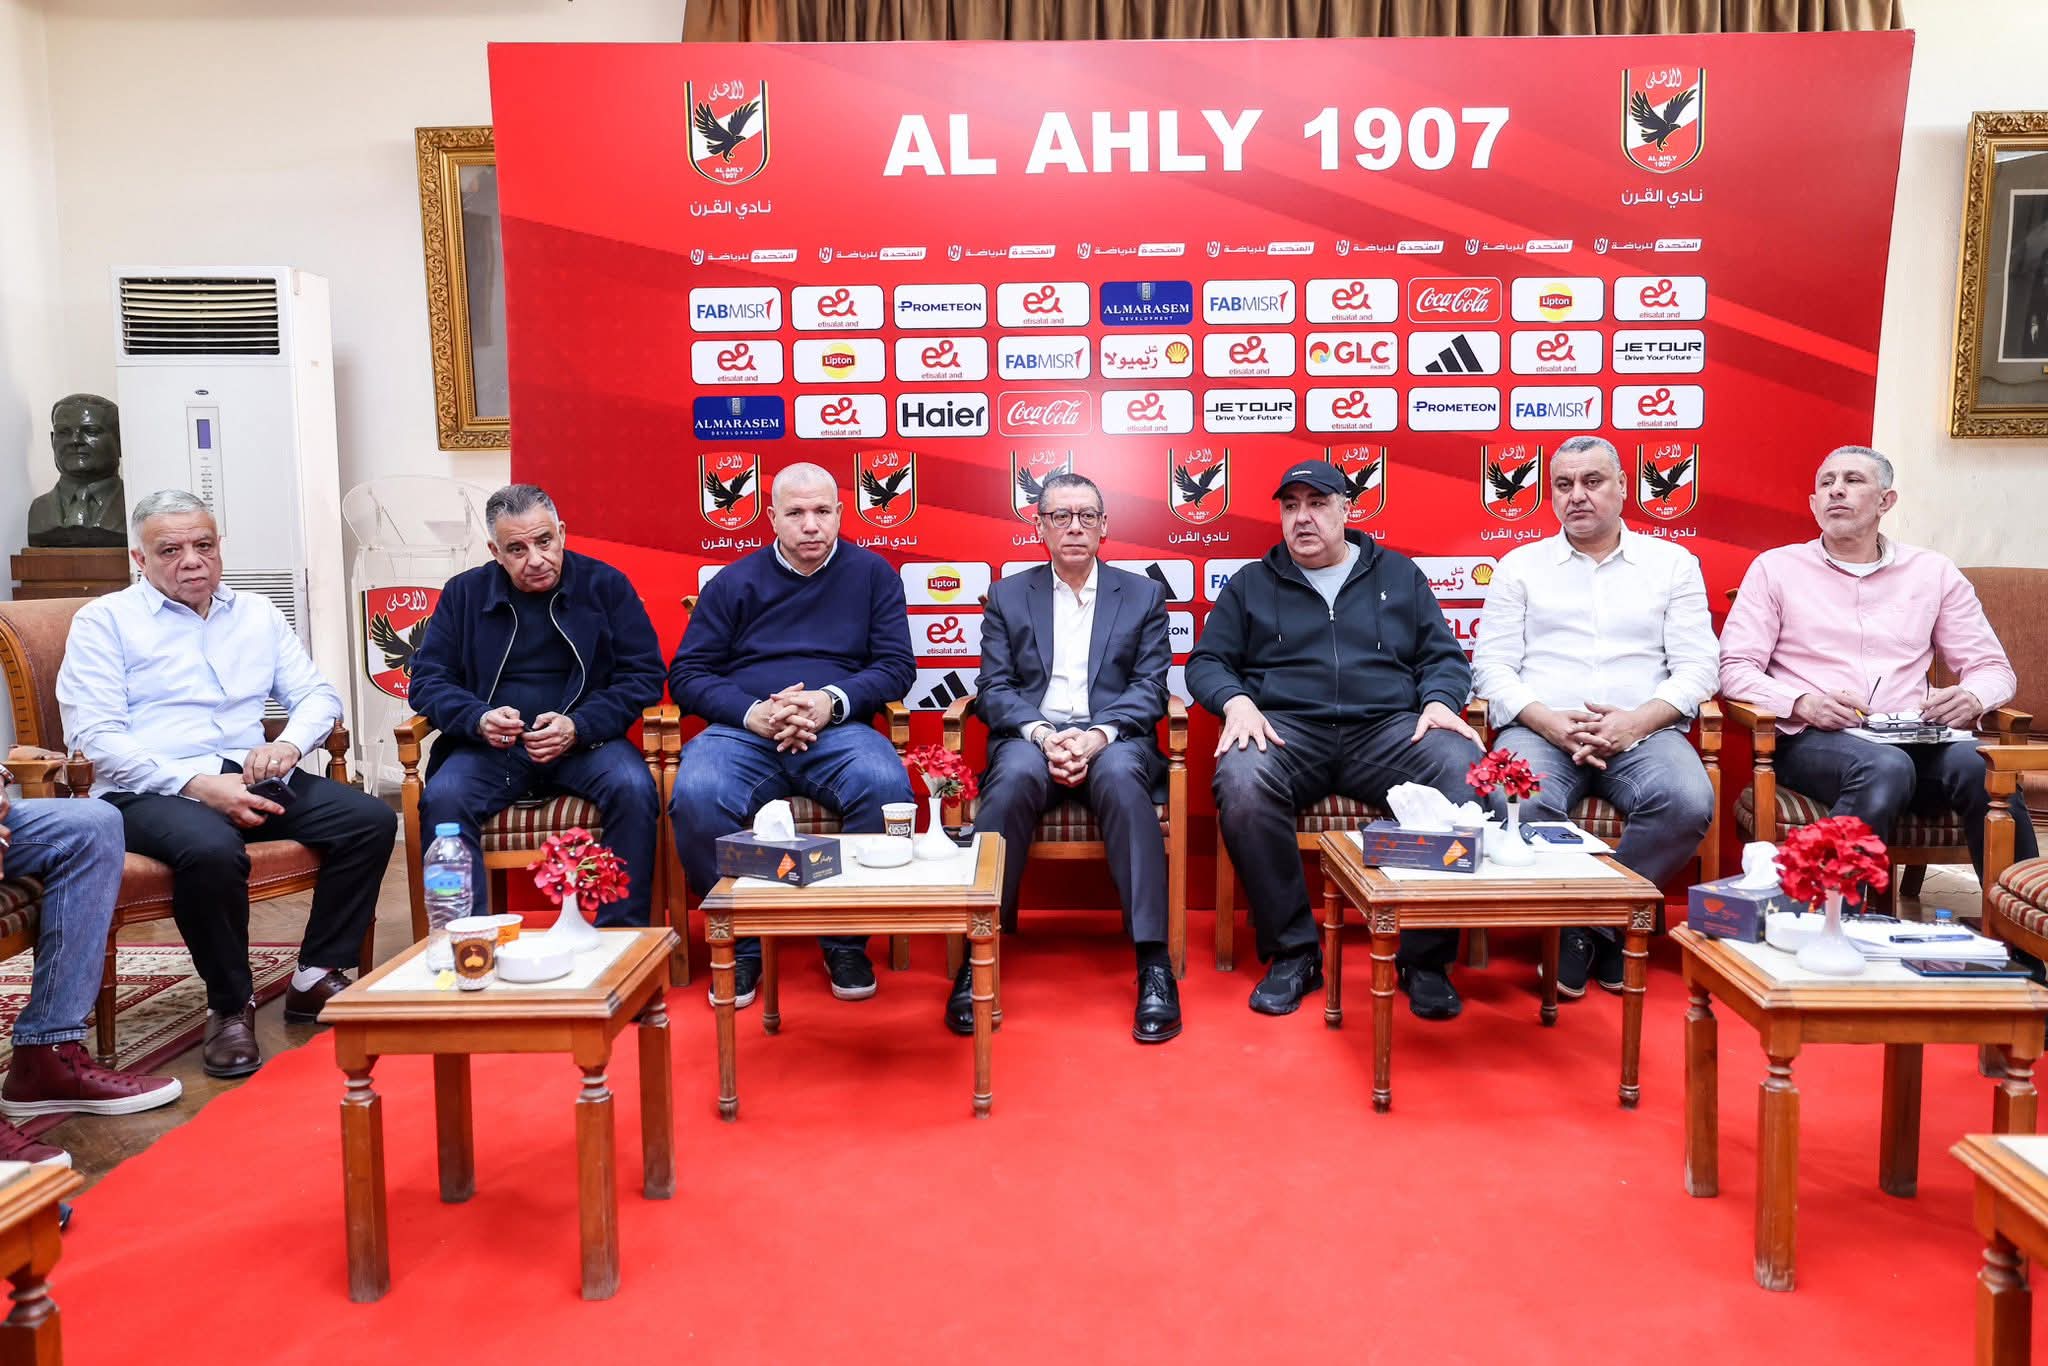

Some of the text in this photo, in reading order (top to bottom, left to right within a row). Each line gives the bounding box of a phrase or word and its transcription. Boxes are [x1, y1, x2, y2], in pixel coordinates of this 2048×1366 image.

[884, 107, 1509, 176] AL AHLY 1907
[1622, 188, 1702, 208] نادي القرن
[690, 200, 771, 219] نادي القرن
[1140, 246, 1181, 255] المتحدة
[1270, 245, 1311, 254] المتحدة
[1399, 243, 1440, 252] المتحدة
[1528, 242, 1569, 251] المتحدة
[1657, 241, 1698, 250] المتحدة
[753, 251, 794, 261] المتحدة
[882, 249, 923, 259] المتحدة
[1011, 247, 1052, 256] المتحدة
[898, 301, 981, 311] PROMETEON
[1542, 297, 1570, 307] Lipton
[1104, 304, 1189, 313] ALMARASEM
[1145, 346, 1158, 354] شل
[1616, 342, 1701, 352] JETOUR
[1334, 341, 1389, 364] GLC
[823, 356, 852, 365] Lipton
[1104, 352, 1158, 370] ريميولا
[1206, 403, 1292, 412] JETOUR
[1413, 401, 1496, 412] PROMETEON
[902, 401, 984, 427] Haier
[695, 419, 778, 428] ALMARASEM
[1012, 533, 1044, 545] لقرن
[1169, 531, 1229, 546] نادي القرن
[1481, 528, 1541, 542] نادي القرن
[1670, 528, 1696, 541] نادي
[702, 537, 761, 552] نادي القرن
[857, 536, 917, 549] نادي القرن
[1451, 567, 1464, 576] شل
[930, 578, 957, 589] Lipton
[1427, 577, 1464, 591] ريميو
